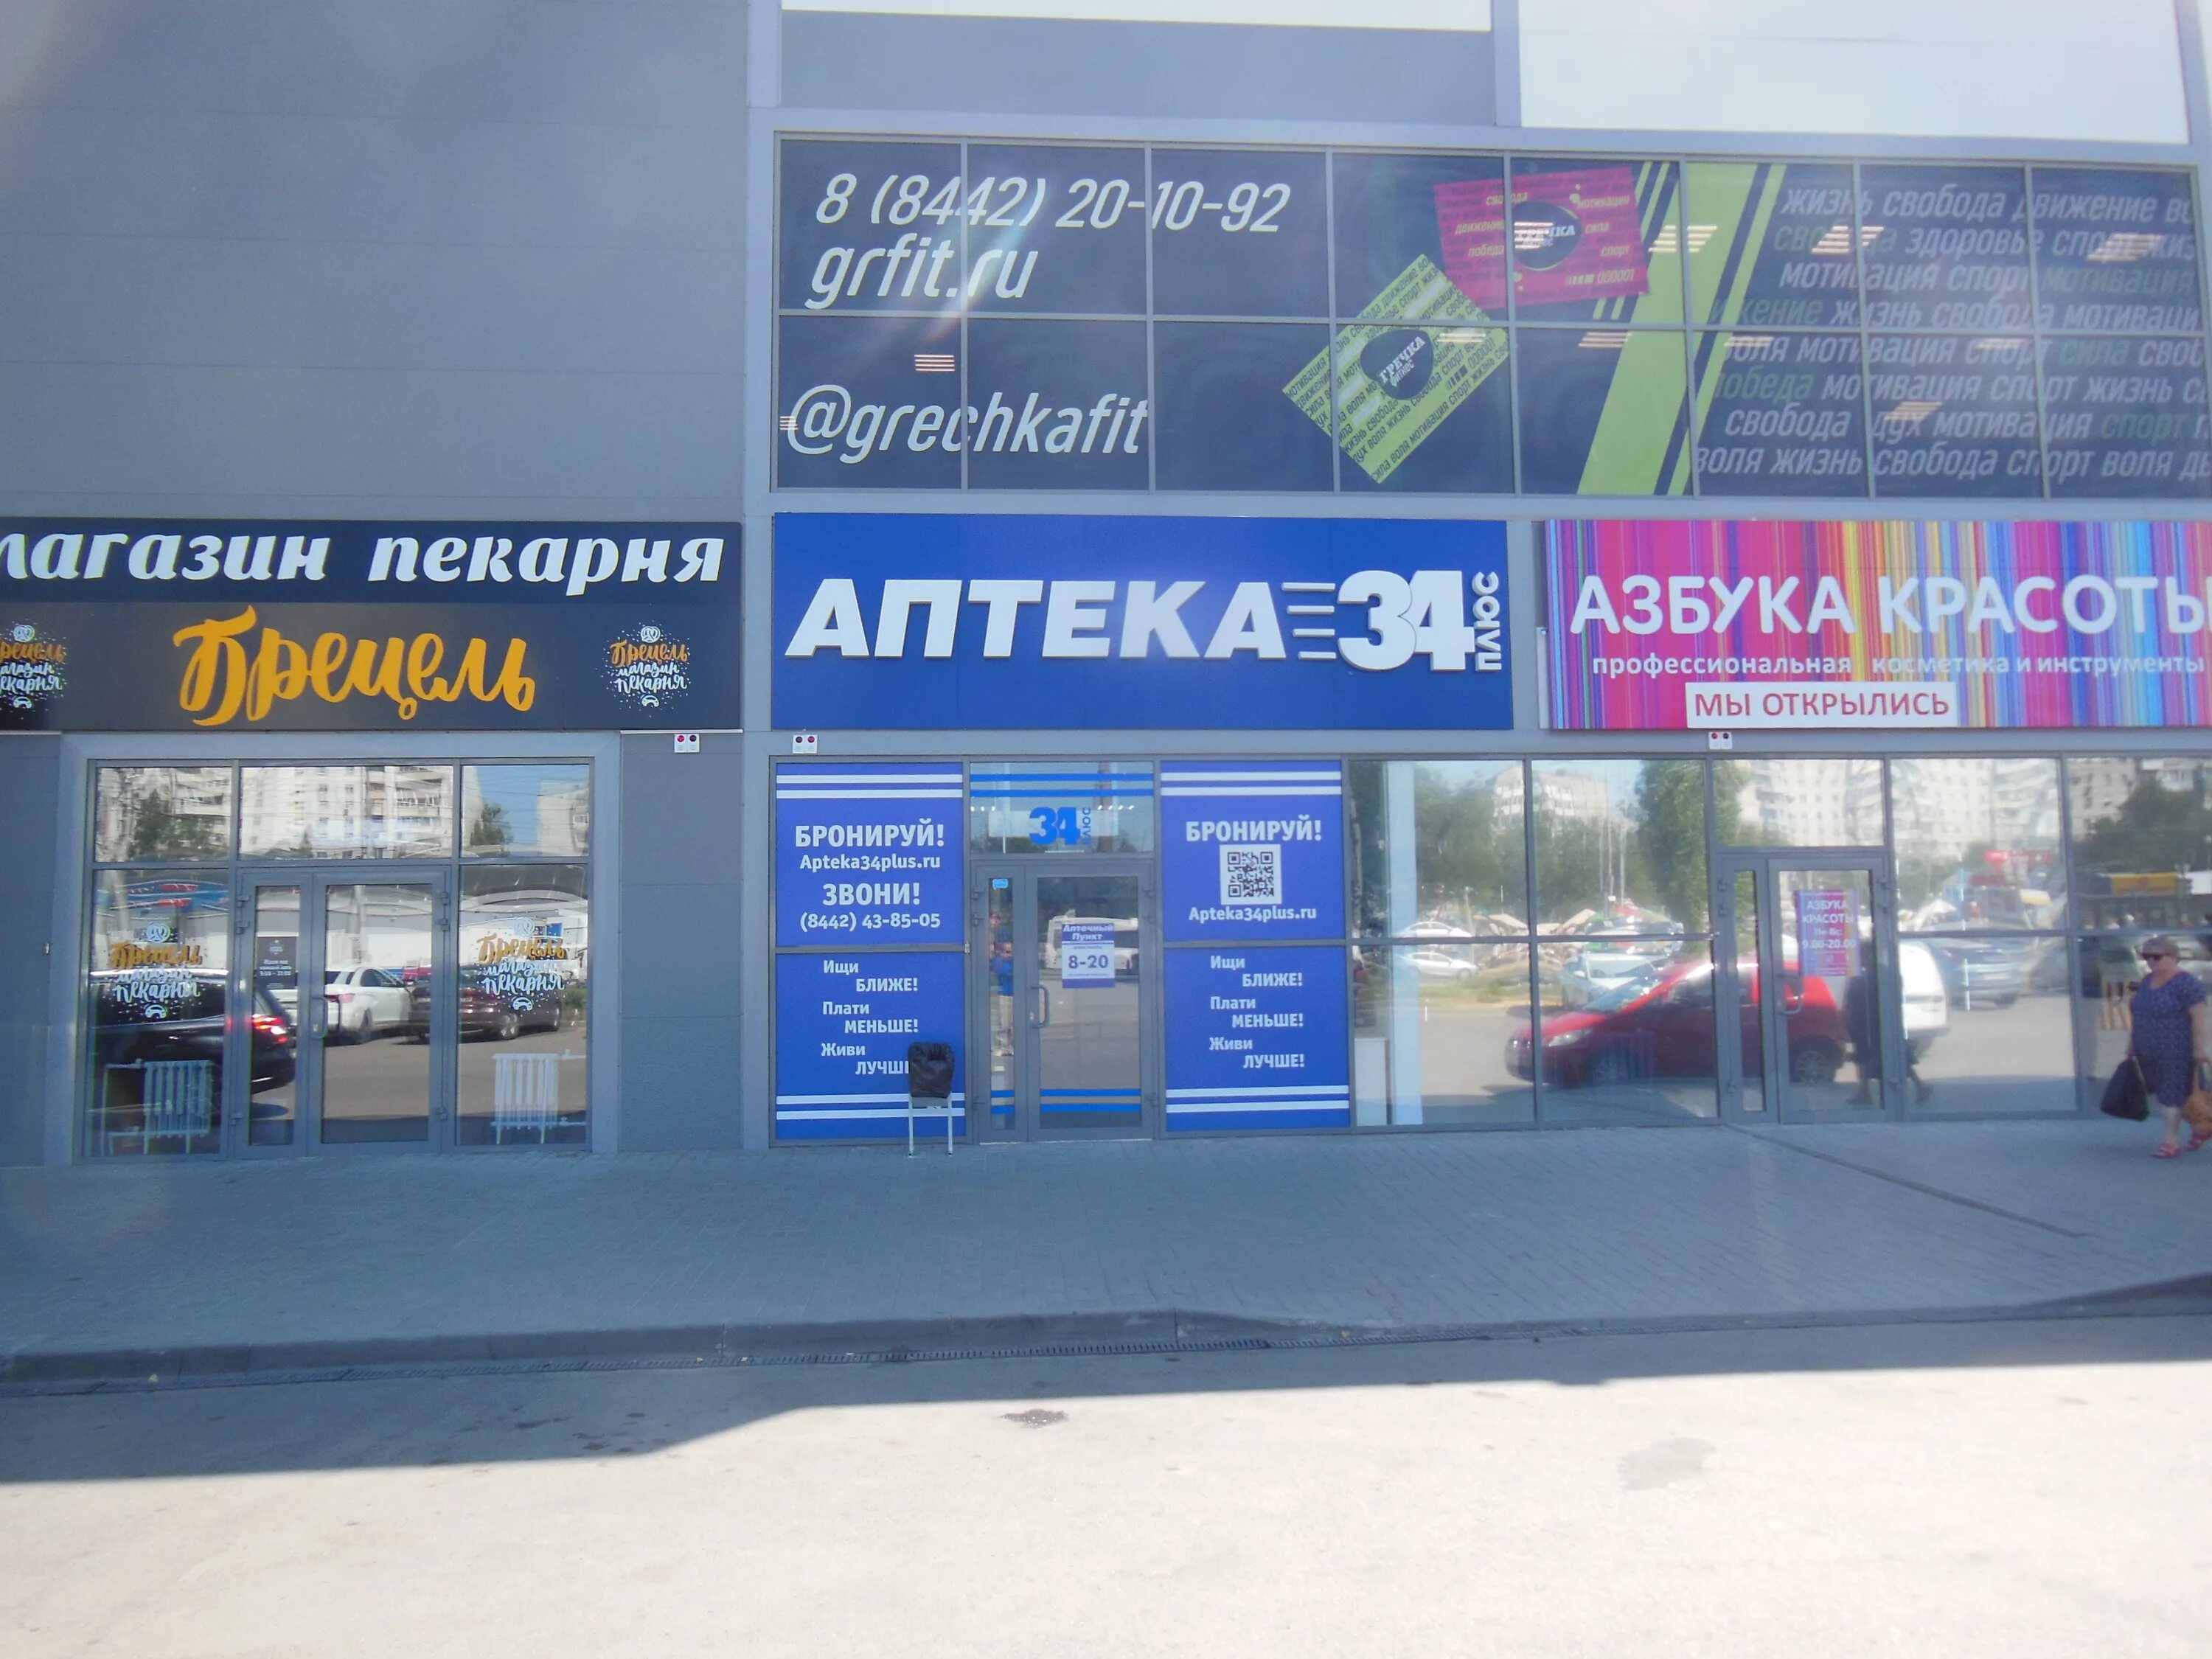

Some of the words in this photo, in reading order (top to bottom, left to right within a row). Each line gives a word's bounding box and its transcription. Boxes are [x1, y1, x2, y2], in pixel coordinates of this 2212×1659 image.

[815, 173, 858, 223] 8
[871, 174, 1046, 228] (8442)
[1056, 178, 1291, 233] 20-10-92
[1882, 184, 2005, 221] свобода
[805, 232, 1038, 310] grfit.ru
[2084, 377, 2173, 403] жизнь
[788, 384, 1148, 464] @grechkafit
[1725, 402, 1851, 442] свобода
[1770, 448, 1864, 474] жизнь
[1875, 441, 1997, 480] свобода
[2102, 451, 2174, 477] воля
[369, 536, 724, 596] пекарня
[1570, 575, 1857, 636] АЗБУКА
[784, 578, 1287, 661] АПТЕКА
[1337, 570, 1476, 672] 34
[1472, 571, 1502, 672] ПЛЮС
[173, 605, 537, 726] Брецель
[611, 639, 688, 667] Брецель
[1593, 652, 1852, 678] профессиональная
[1873, 655, 2010, 675] косметика
[2017, 657, 2031, 673] и
[2037, 656, 2205, 678] инструменты
[1695, 693, 1750, 716] МЫ
[1762, 692, 1949, 717] ОТКРЫЛИСЬ
[795, 818, 945, 847] БРОНИРУЙ!
[1029, 806, 1081, 845] 34
[1186, 815, 1321, 842] БРОНИРУЙ!
[800, 855, 941, 872] Apteka34plus.ru
[823, 883, 921, 906] ЗВОНИ!
[800, 912, 857, 932] (8442)
[862, 913, 941, 930] 43-85-05
[1189, 905, 1317, 923] Apteka34plus.ru
[824, 960, 859, 976] Ищи
[1068, 955, 1108, 968] 8-20
[1210, 956, 1245, 970] Ищи
[855, 978, 918, 992] БЛИЖЕ!
[1242, 973, 1303, 987] БЛИЖЕ!
[823, 1001, 869, 1015] Плати
[1210, 997, 1256, 1010] Плати
[844, 1019, 918, 1034] МЕНЬШЕ!
[1232, 1013, 1304, 1028] МЕНЬШЕ!
[821, 1043, 866, 1057] Живи
[1209, 1037, 1253, 1051] Живи
[1243, 1054, 1304, 1068] ЛУЧШЕ!
